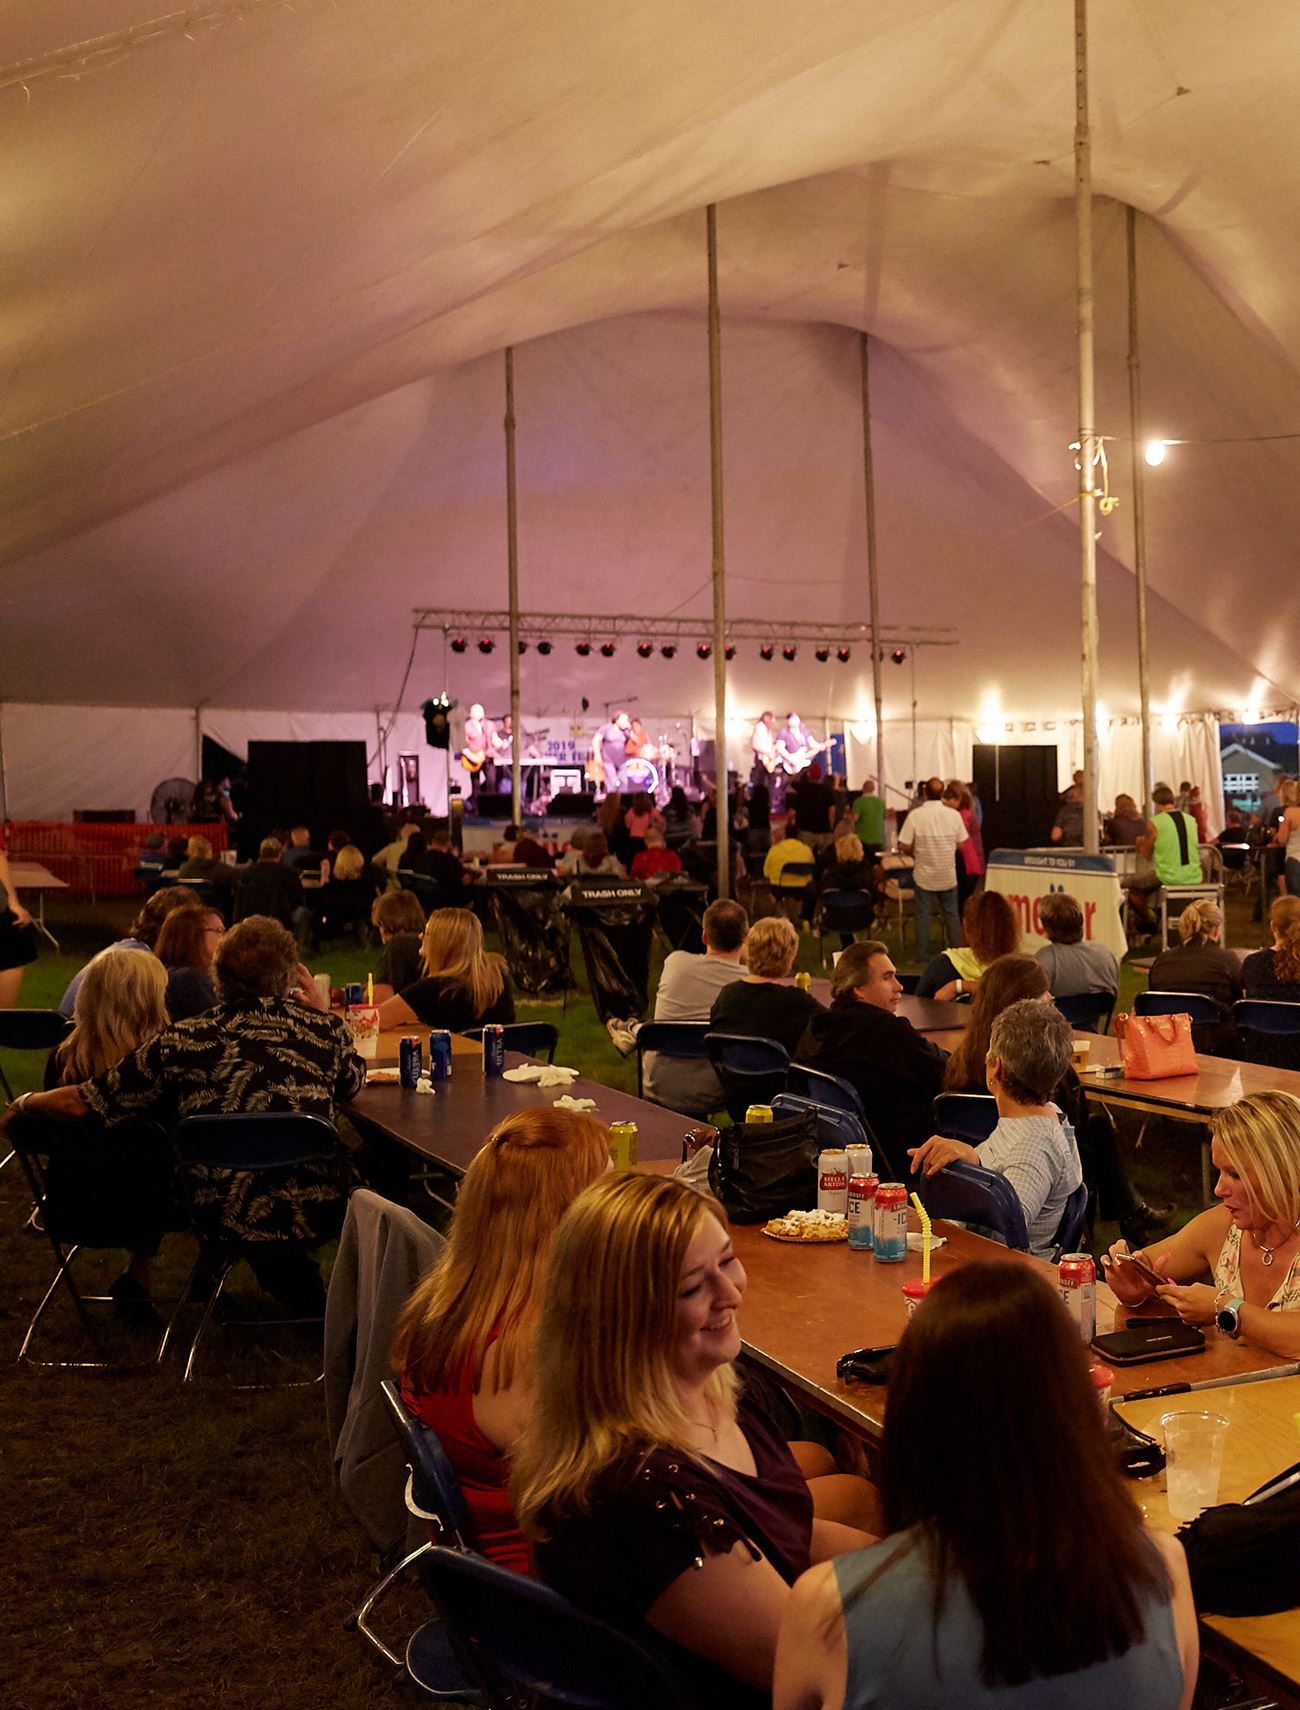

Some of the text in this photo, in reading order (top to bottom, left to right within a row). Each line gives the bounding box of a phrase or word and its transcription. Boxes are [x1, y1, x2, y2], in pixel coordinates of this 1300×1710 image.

[547, 740, 576, 750] 2019
[496, 873, 526, 881] TRASH
[582, 888, 642, 899] TRASH ONLY
